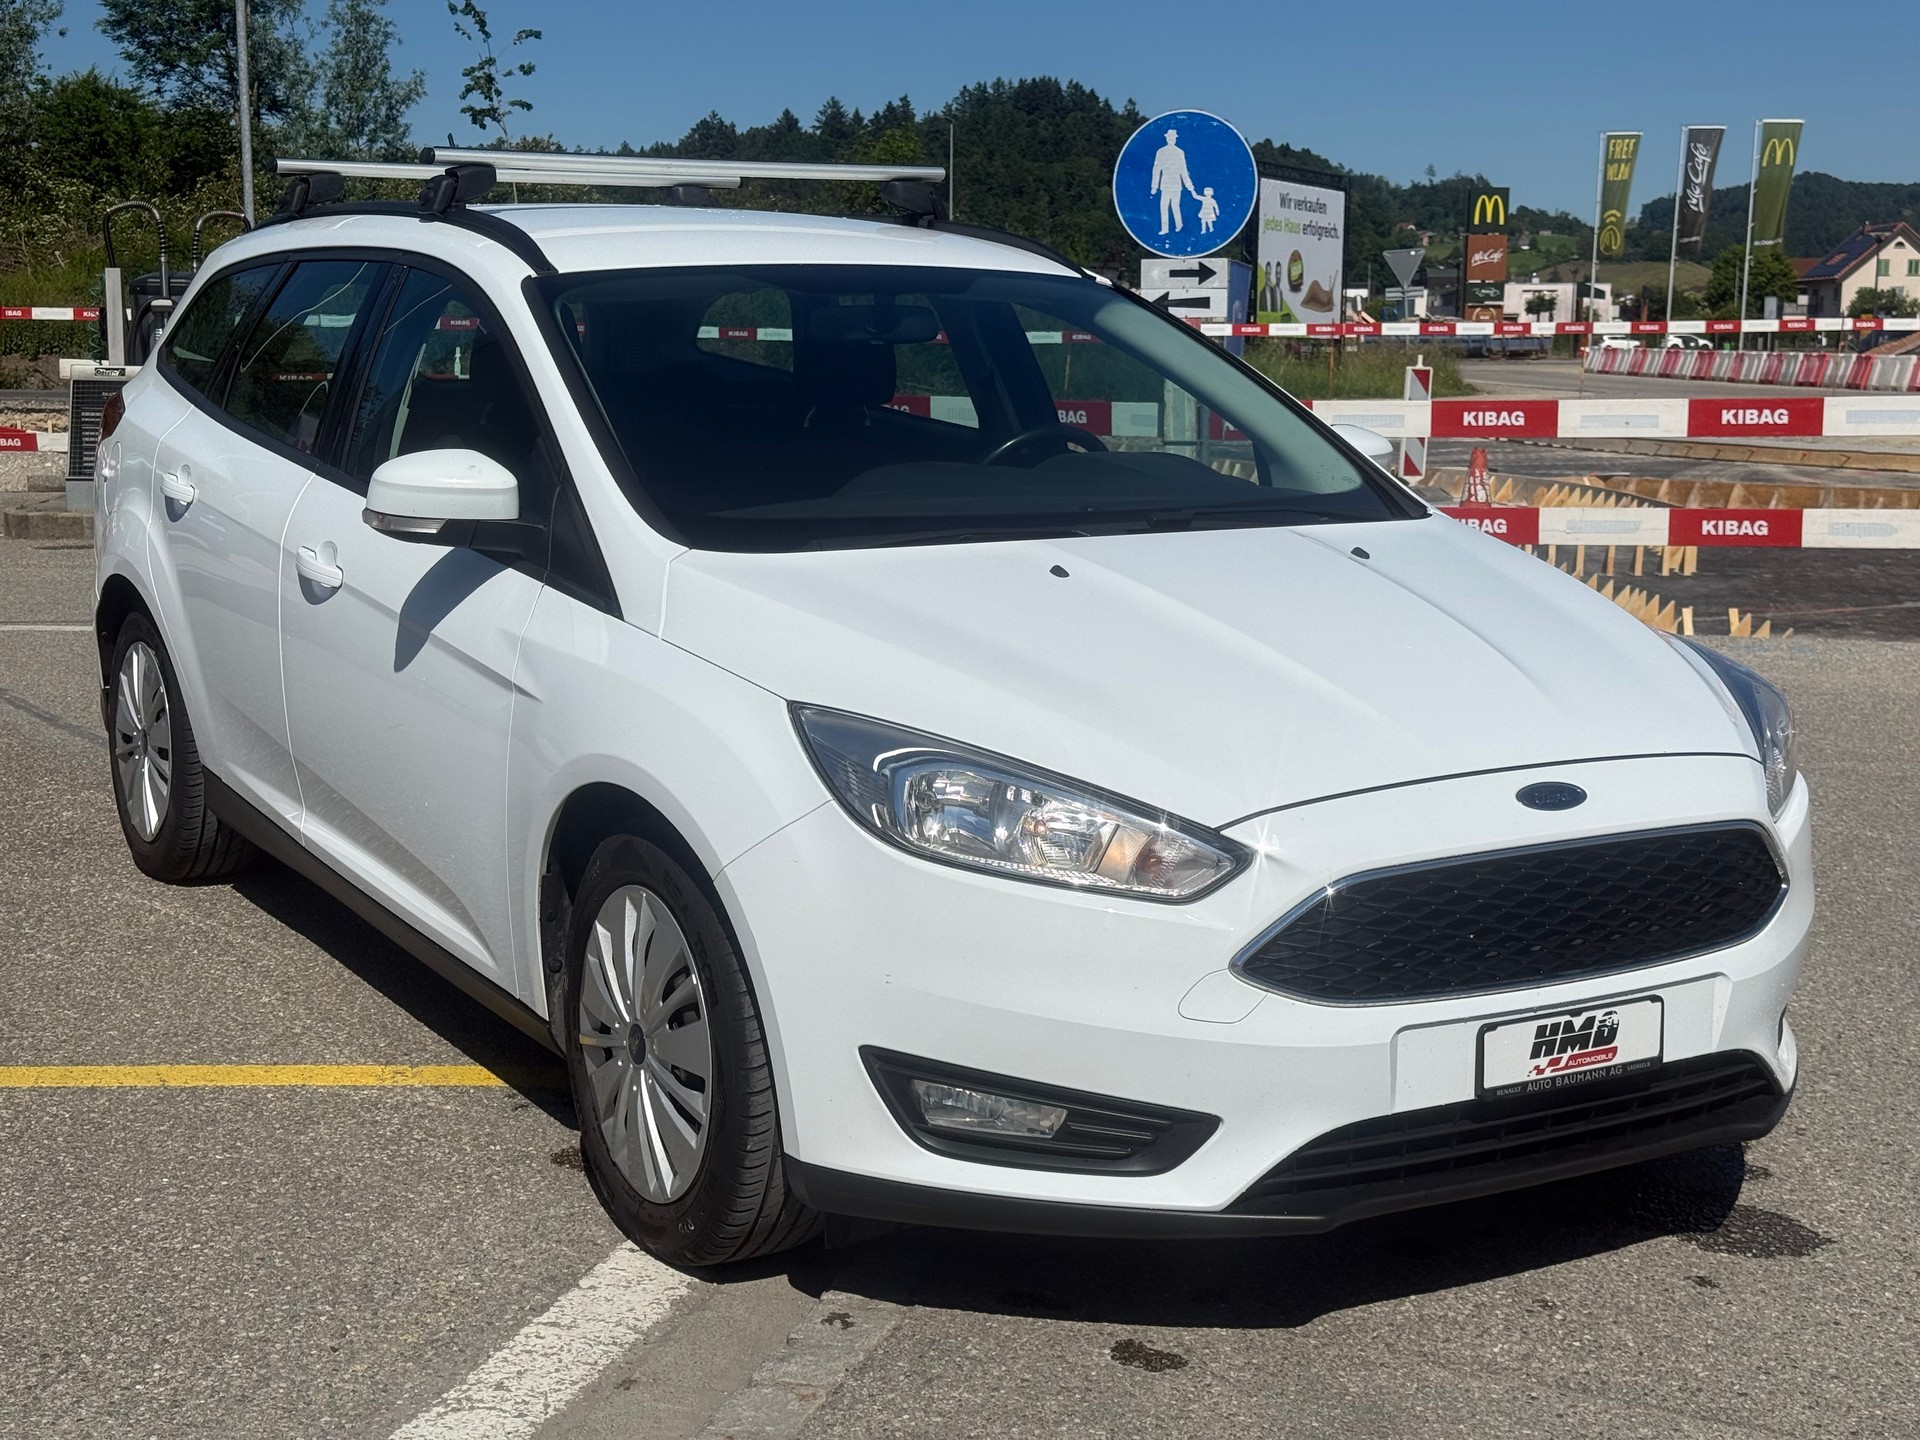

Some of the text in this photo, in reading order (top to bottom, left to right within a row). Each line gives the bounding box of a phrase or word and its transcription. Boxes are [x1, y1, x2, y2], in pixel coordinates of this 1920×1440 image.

[1608, 138, 1636, 160] FREE
[1279, 192, 1327, 215] Wir verkaufen
[1263, 213, 1340, 241] jedes Haus erfolgreich.
[1462, 410, 1526, 427] KIBAG
[1720, 408, 1789, 425] KIBAG
[1701, 519, 1769, 536] KIBAG
[1568, 1052, 1614, 1067] AUTOMOBILE
[1526, 1078, 1552, 1093] AUTO
[1555, 1067, 1607, 1088] BAUMANN
[1609, 1064, 1623, 1076] AG
